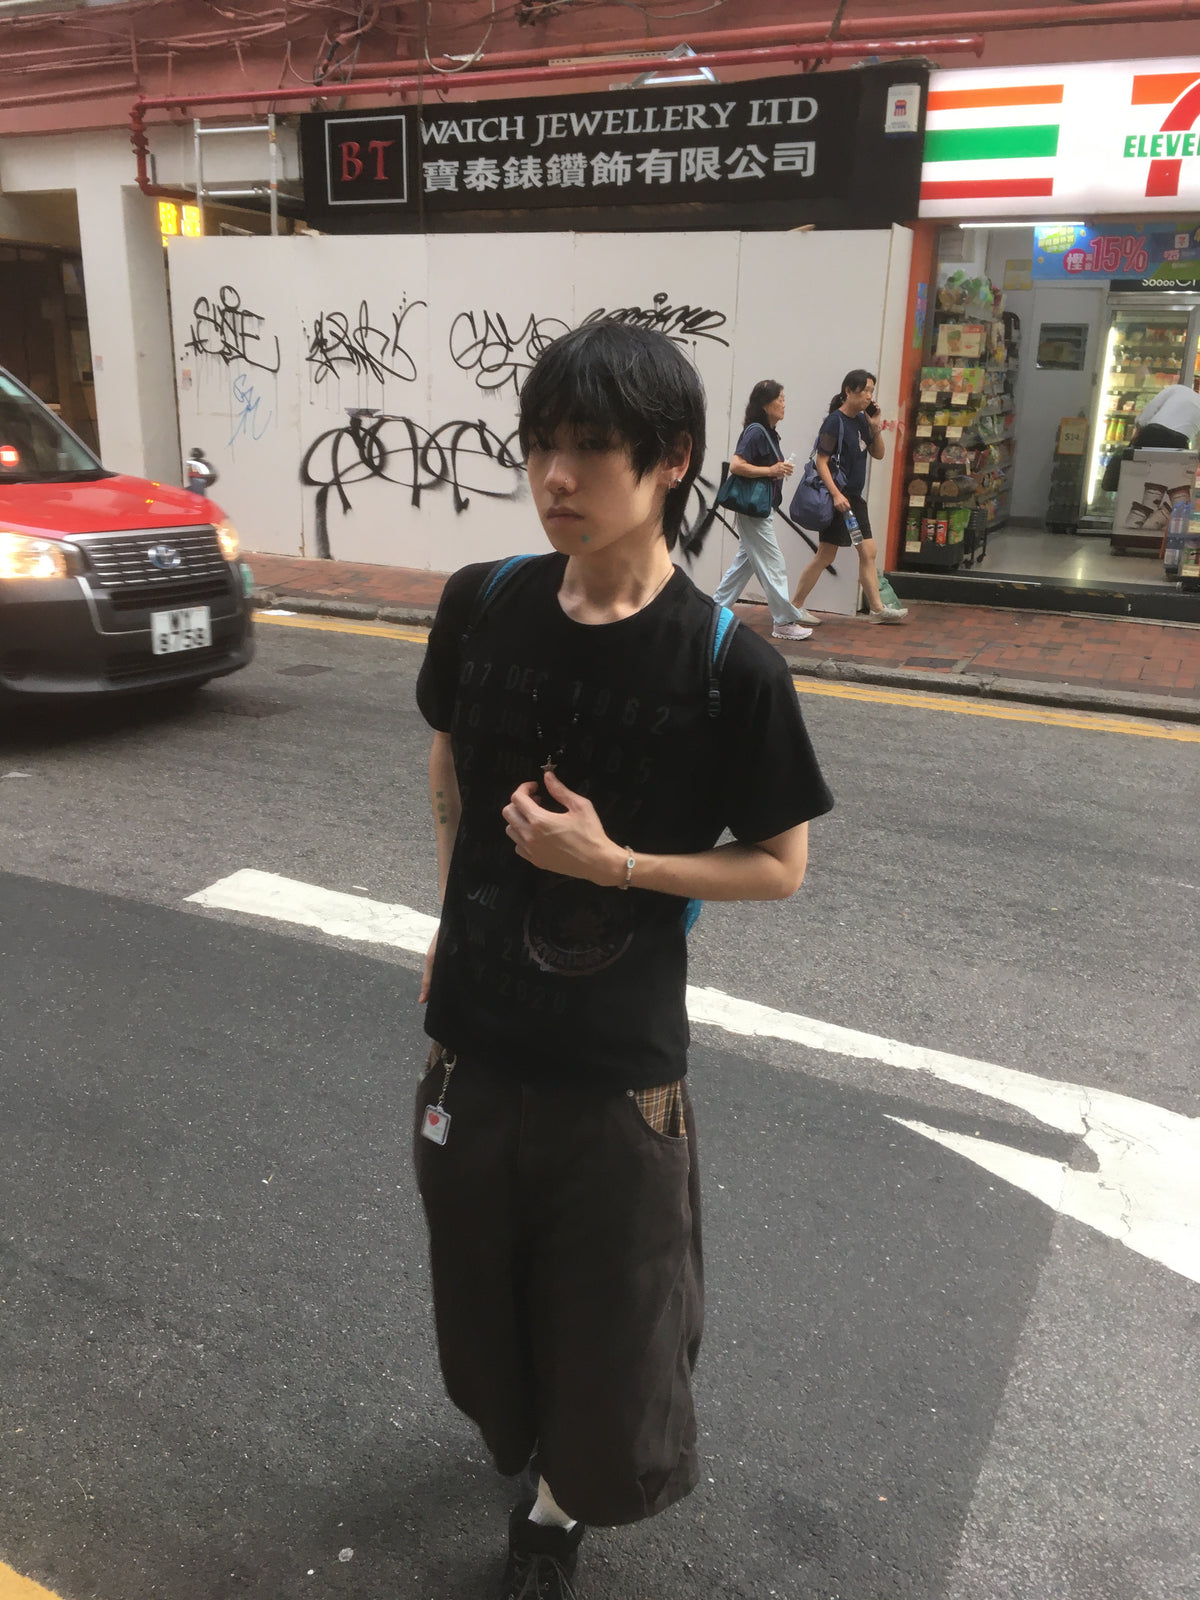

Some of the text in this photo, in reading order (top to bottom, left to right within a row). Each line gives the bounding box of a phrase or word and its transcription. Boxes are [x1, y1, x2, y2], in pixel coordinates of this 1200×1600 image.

[421, 97, 819, 147] WATCH JEWELLERY LTD
[338, 139, 396, 181] BT
[1123, 133, 1200, 158] ELEVE
[422, 141, 816, 193] 寶泰錶鑽飾有限公司
[466, 882, 502, 911] JUL
